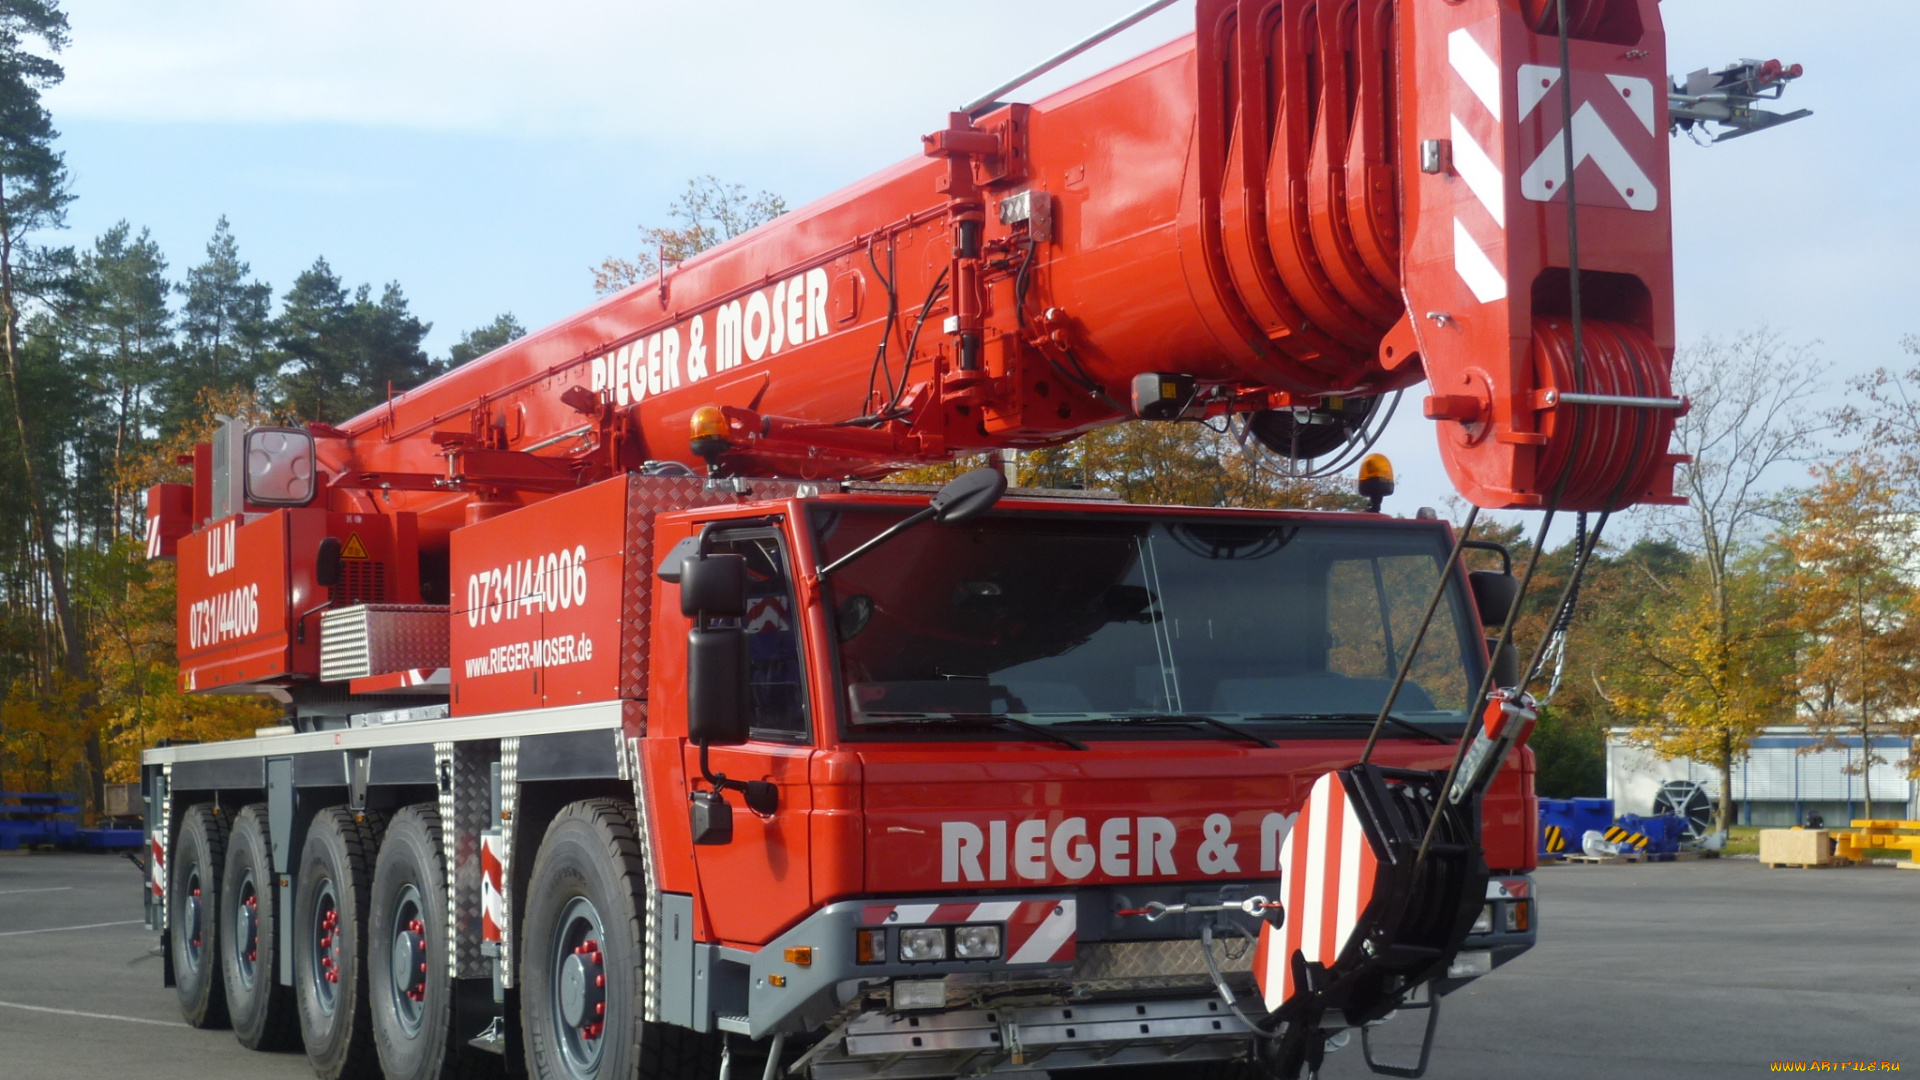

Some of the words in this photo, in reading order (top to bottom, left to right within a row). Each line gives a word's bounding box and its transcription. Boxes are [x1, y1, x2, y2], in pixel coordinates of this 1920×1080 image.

[591, 327, 681, 406] RIEGER
[687, 314, 709, 383] &
[715, 267, 829, 373] MOSER
[207, 520, 236, 578] ULM
[189, 582, 259, 650] 0731/44006
[467, 544, 588, 628] 0731/44006
[465, 632, 593, 679] www.RIEGER-MOSER.de
[941, 816, 1178, 883] RIEGER
[1197, 813, 1241, 875] &
[1260, 811, 1300, 872] M
